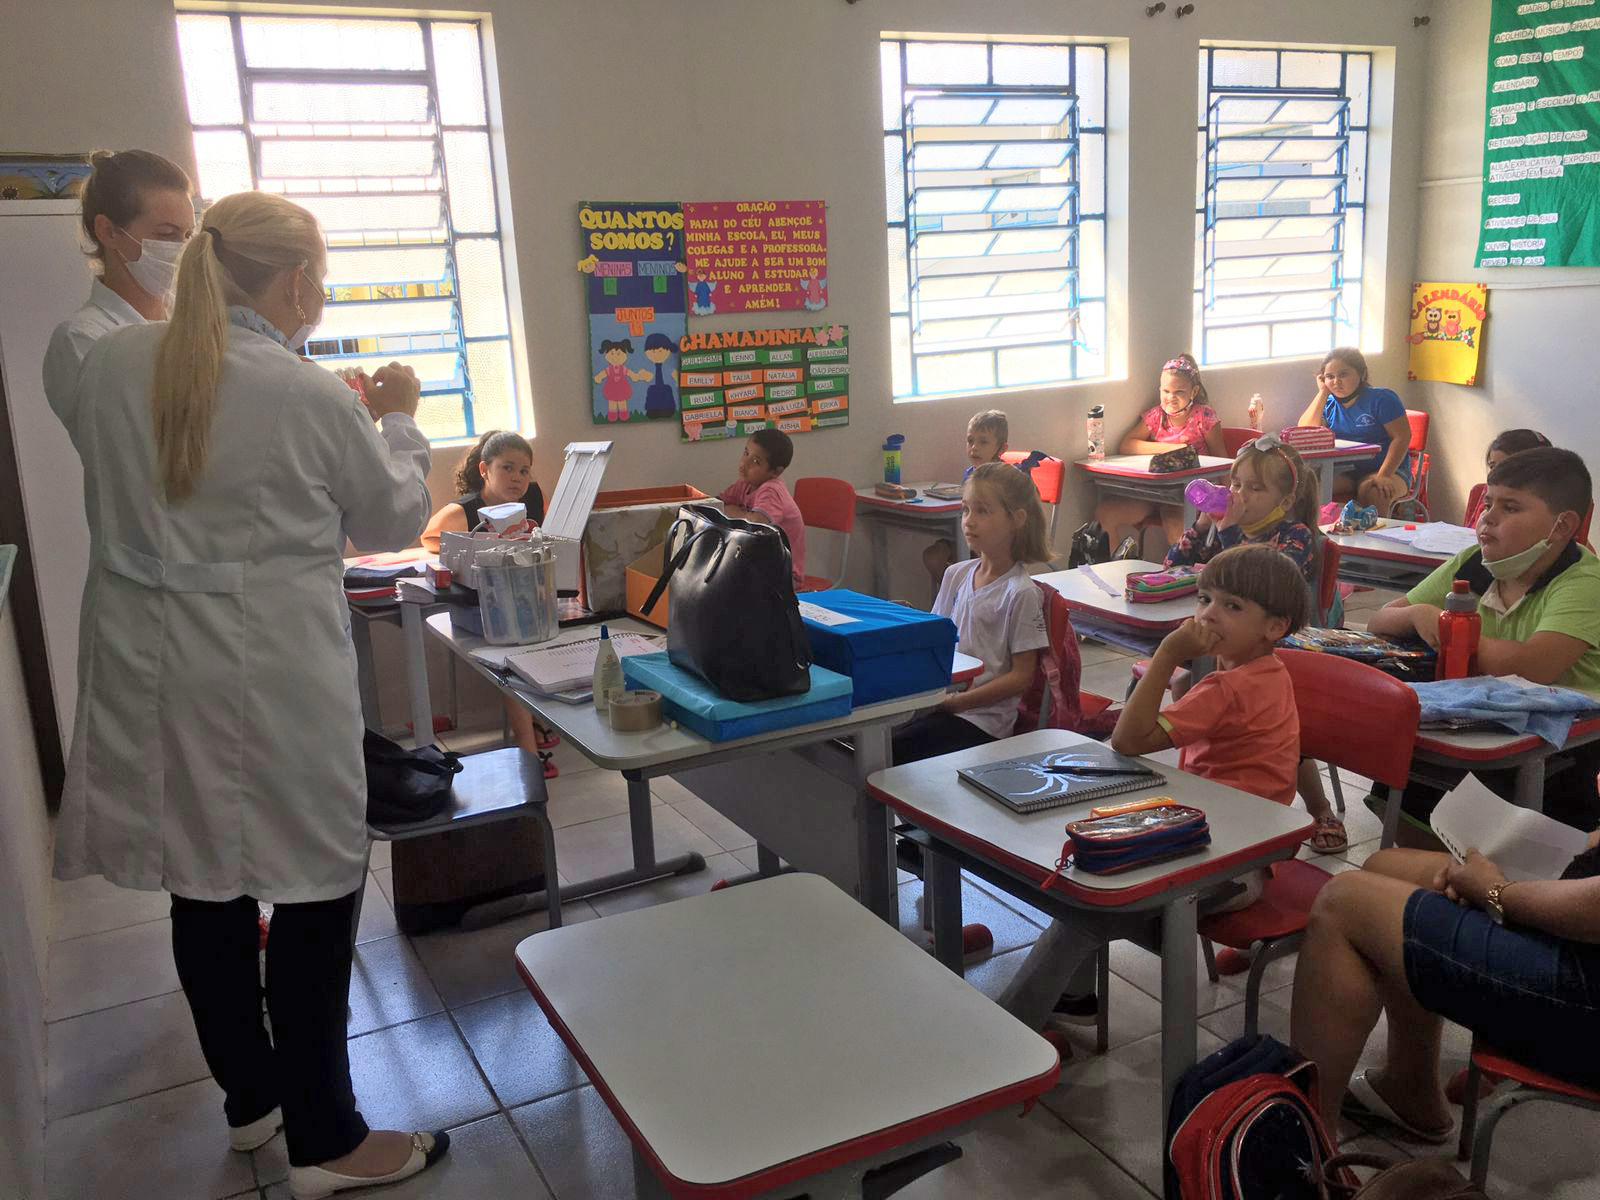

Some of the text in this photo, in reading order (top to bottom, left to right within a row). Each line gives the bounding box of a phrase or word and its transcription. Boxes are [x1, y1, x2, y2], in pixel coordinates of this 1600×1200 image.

[1495, 30, 1533, 42] ACOLHIDA
[1495, 56, 1517, 66] COMO
[1544, 53, 1551, 62] O
[1554, 48, 1583, 60] TEMPO?
[1491, 103, 1525, 115] CHAMADA
[1536, 96, 1575, 108] ESCOLHA
[1489, 137, 1524, 148] RETOMAR
[1550, 133, 1562, 142] DE
[1564, 130, 1586, 140] CASA
[1491, 161, 1509, 171] AULA
[1511, 157, 1556, 168] EXPLICATIVA
[1490, 170, 1526, 181] ATIVIDADE
[1542, 167, 1562, 176] SALA
[1488, 195, 1519, 205] RECREIO
[736, 201, 776, 213] ORAÇÃO
[579, 208, 684, 230] QUANTOS
[690, 214, 813, 229] PAPAI DO CÉU ABENÇOE
[1486, 216, 1526, 228] ATIVIDADES
[686, 230, 821, 242] MINHA ESCOLA, EU, MEUS
[687, 245, 734, 255] COLEGAS
[741, 244, 747, 254] E
[750, 244, 758, 254] A
[1485, 242, 1508, 250] OUVIR
[695, 256, 827, 268] ME AJUDE A SER UM BOM
[1482, 258, 1507, 266] DEVER
[709, 268, 808, 280] ALUNO A ESTUDAR
[724, 283, 792, 294] E APRENDER
[745, 294, 780, 309] AMÉM!
[1411, 290, 1486, 320] CALENDÁRIO
[680, 327, 816, 352] CHAMADINHA
[731, 353, 755, 362] LENNO
[771, 352, 792, 361] ALLAN
[808, 348, 847, 358] ALESSANDRO
[688, 377, 714, 385] EMILLY
[693, 395, 714, 404] RUAN
[820, 401, 839, 410] ERIKA
[734, 409, 757, 417] BIANCA
[771, 401, 805, 413] ANA LUIZA
[684, 411, 722, 421] GABRIELLA
